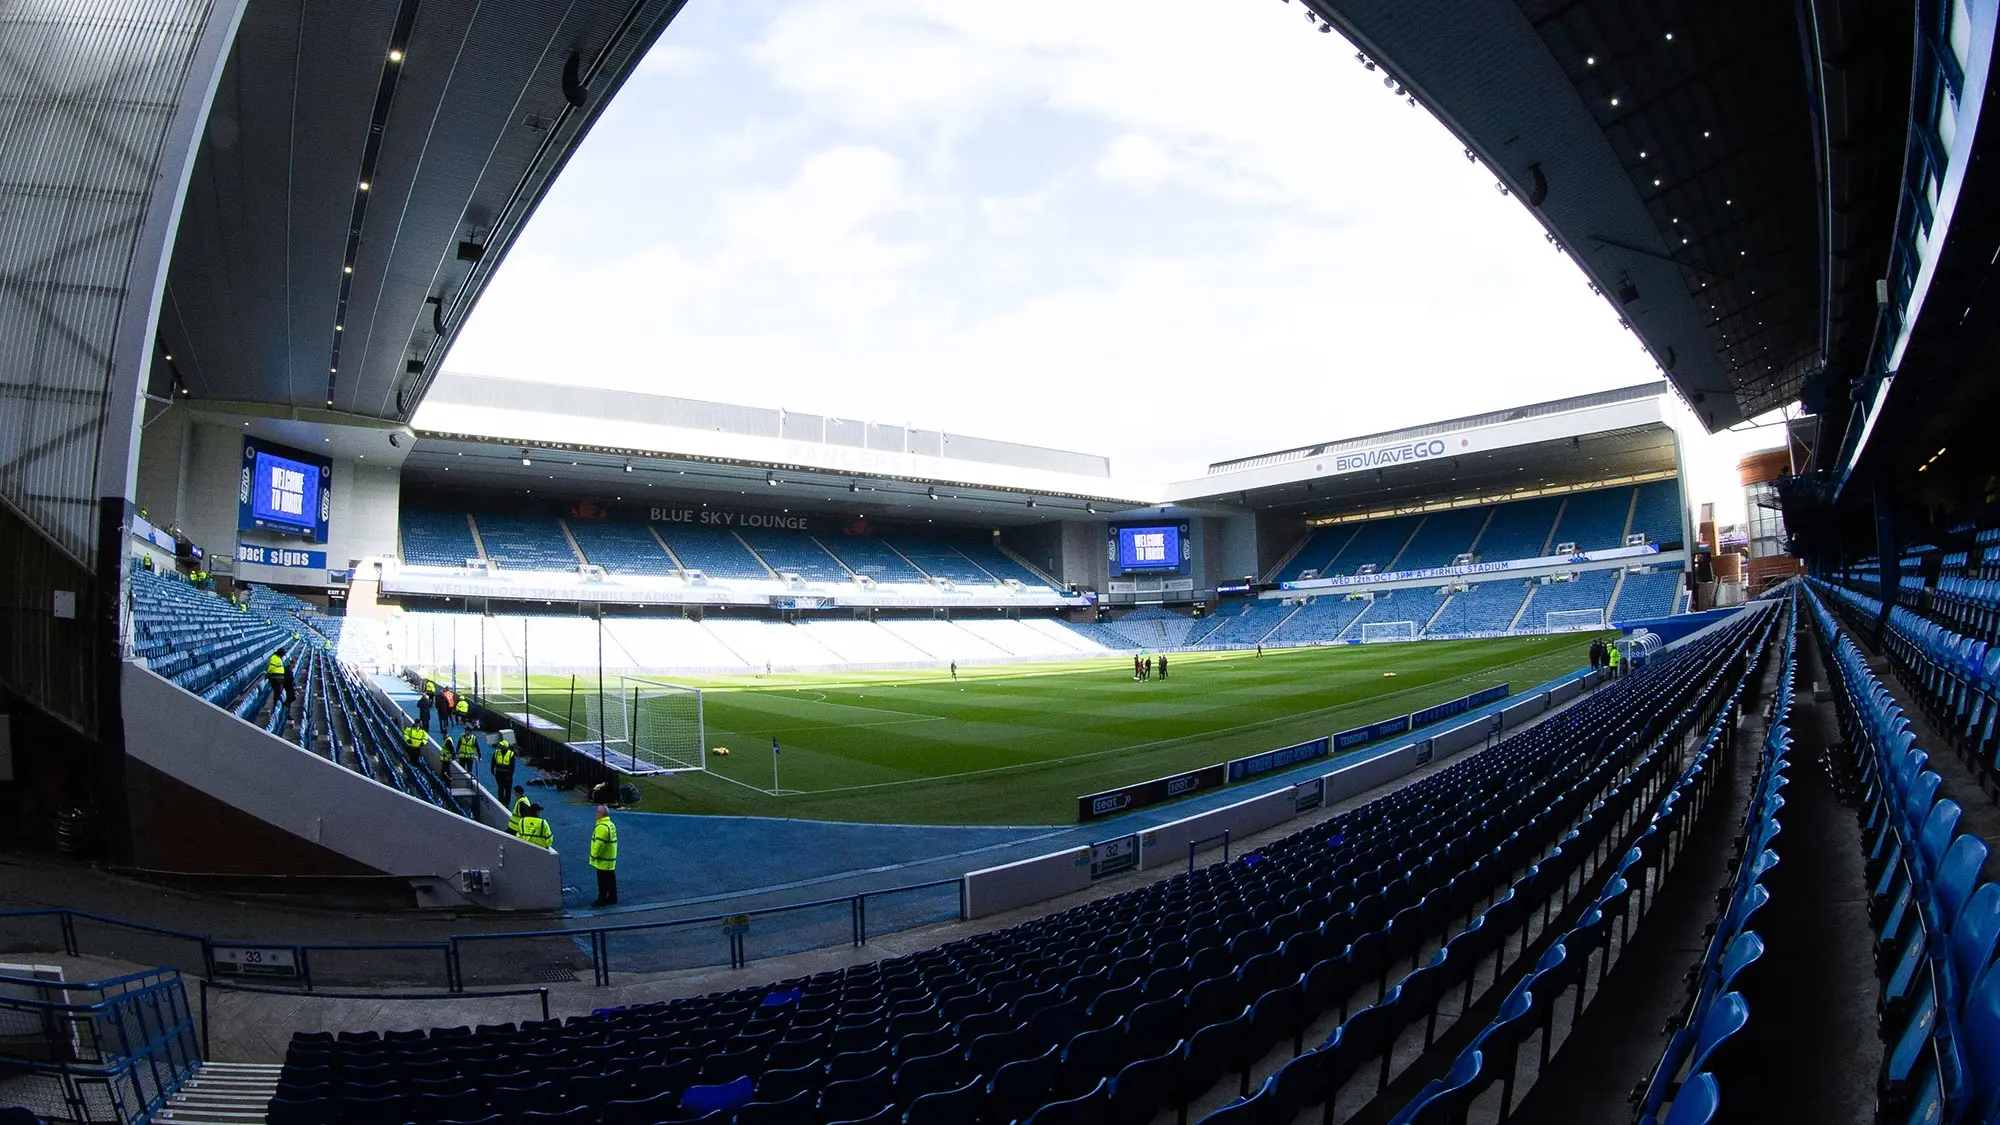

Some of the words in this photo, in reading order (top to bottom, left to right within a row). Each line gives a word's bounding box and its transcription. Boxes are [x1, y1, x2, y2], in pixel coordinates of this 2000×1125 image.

[1336, 440, 1445, 471] BIOWAVEGO
[271, 489, 280, 511] TO
[650, 507, 693, 522] BLUE
[700, 511, 734, 525] SKY
[740, 514, 807, 529] LOUNGE
[270, 550, 309, 566] signs
[1331, 577, 1350, 585] WED
[1354, 575, 1371, 584] 12th
[1374, 573, 1392, 581] OCT
[1396, 571, 1413, 579] 3PM
[1430, 566, 1463, 576] FIRHILL
[1467, 562, 1509, 573] STADIUM
[433, 583, 462, 593] WED
[468, 585, 494, 595] 12th
[499, 587, 525, 597] OCT
[532, 589, 556, 598] 3PM
[561, 590, 576, 598] AT
[631, 592, 683, 602] STADIUM
[1105, 844, 1119, 857] 32
[245, 951, 262, 963] 33
